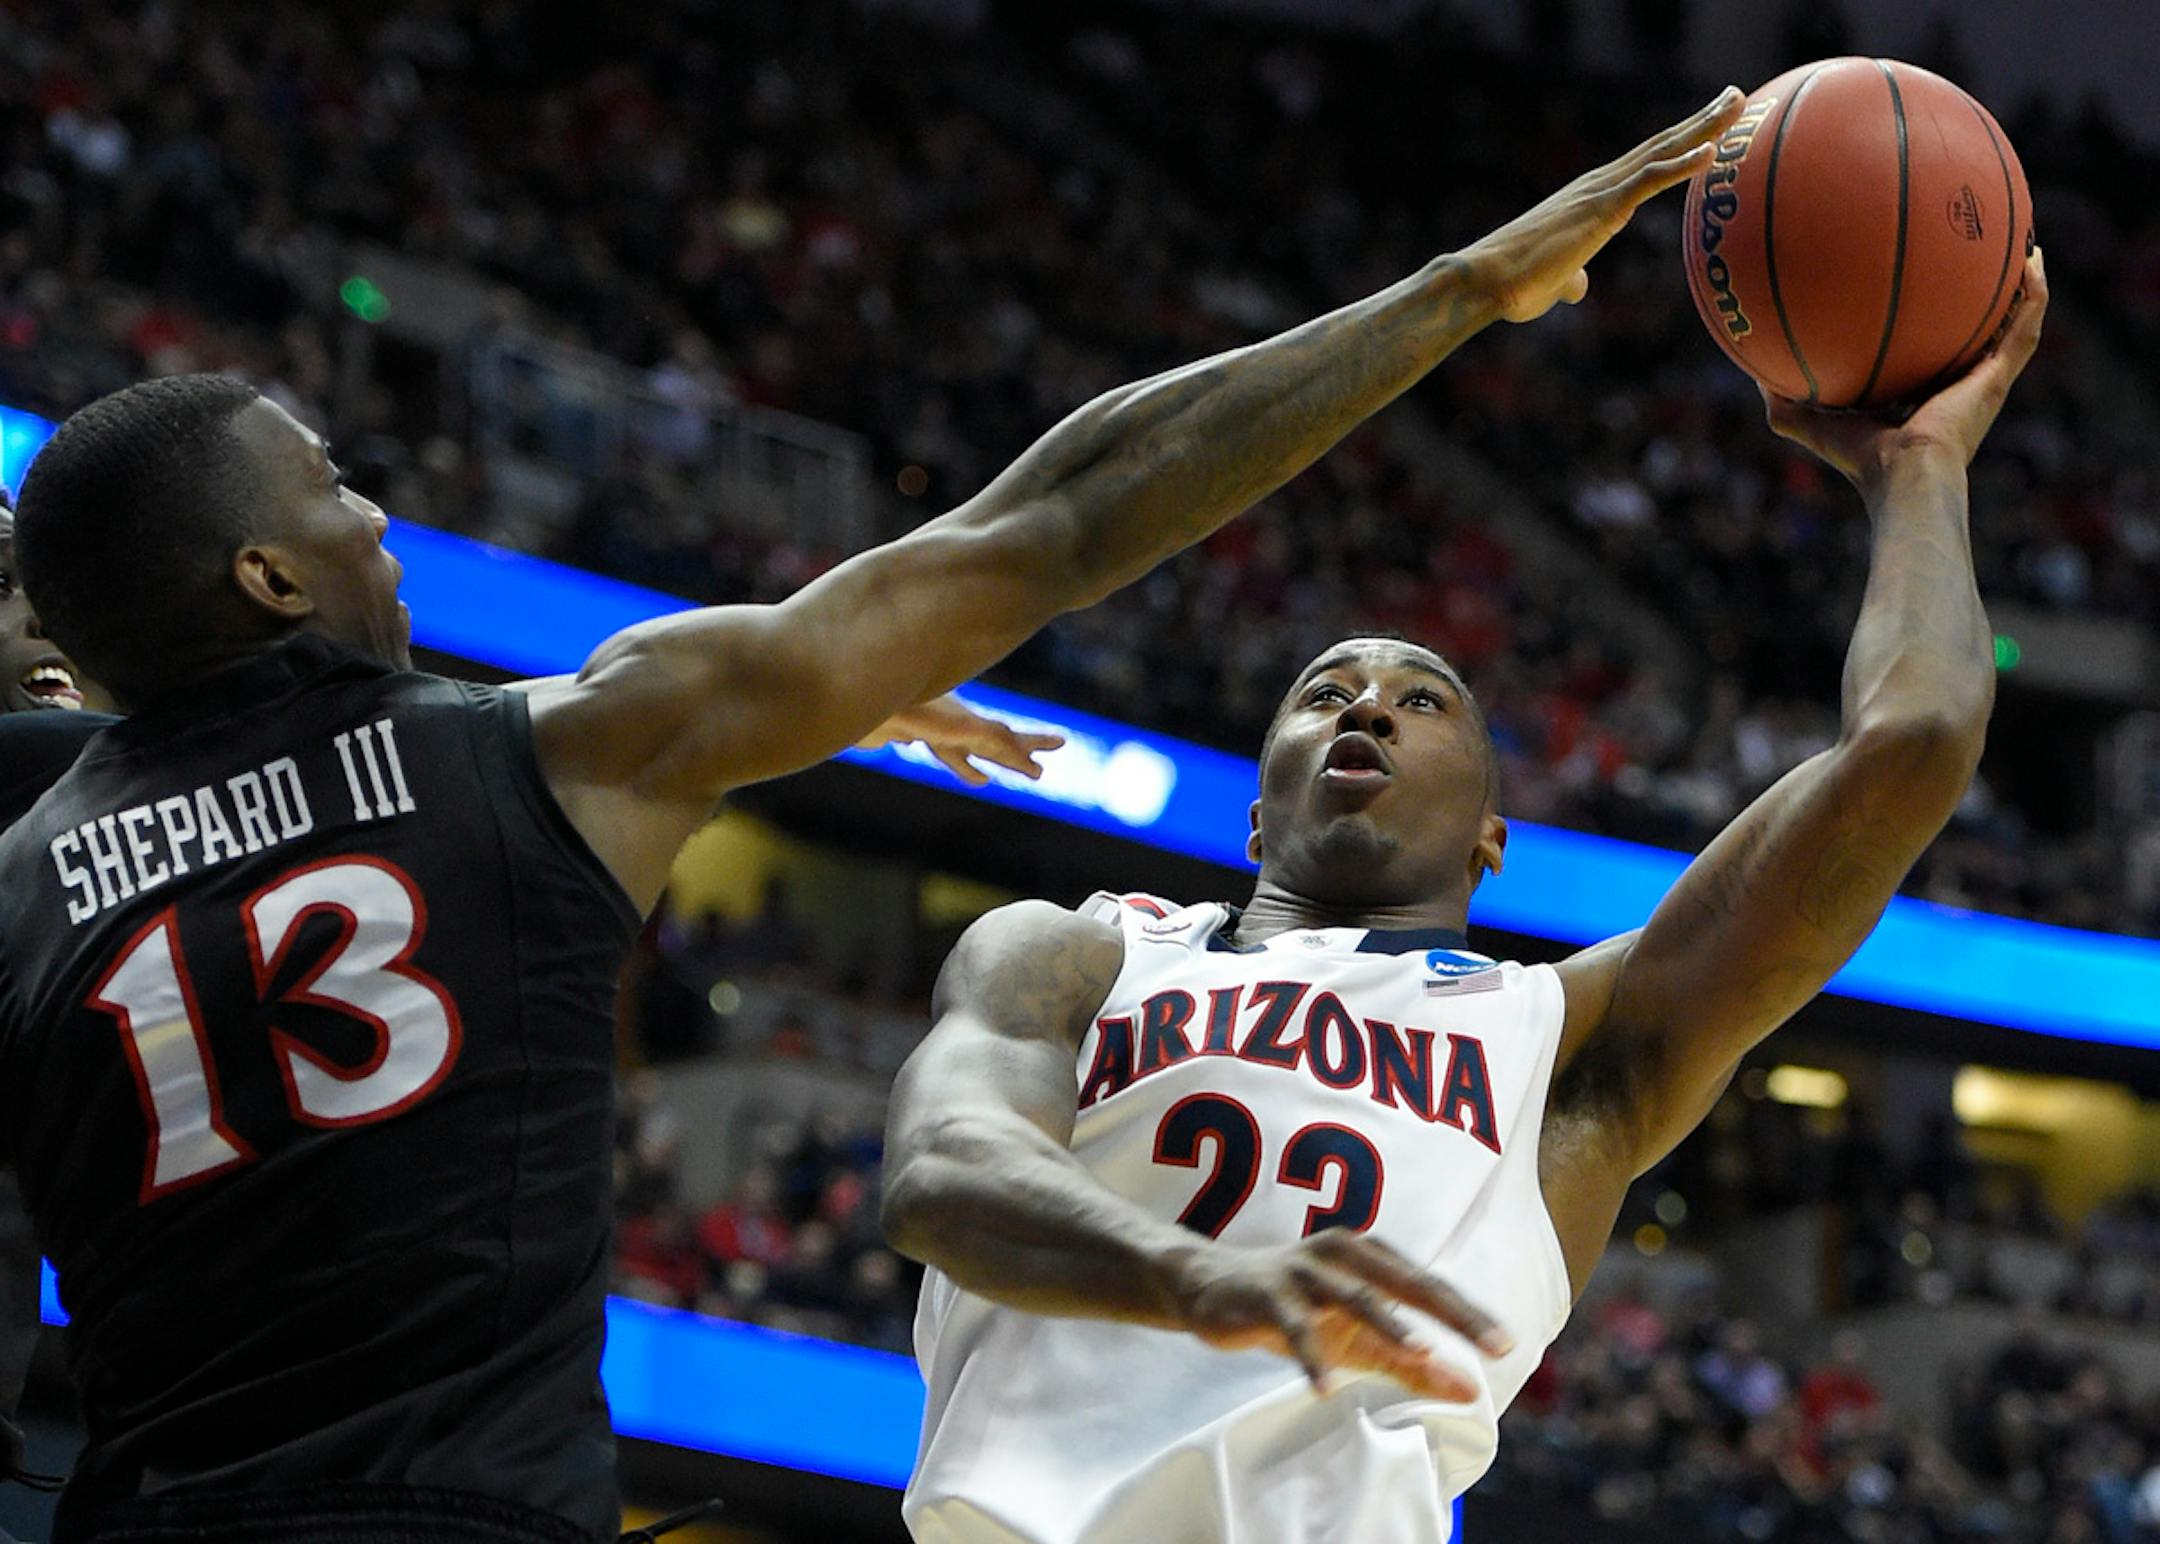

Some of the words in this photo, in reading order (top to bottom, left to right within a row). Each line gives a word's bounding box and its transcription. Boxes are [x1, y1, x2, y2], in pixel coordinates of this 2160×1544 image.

[50, 757, 314, 925] SHEPARD
[334, 718, 415, 821] III
[85, 854, 463, 1205] 13
[1079, 981, 1501, 1155] ARIZONA
